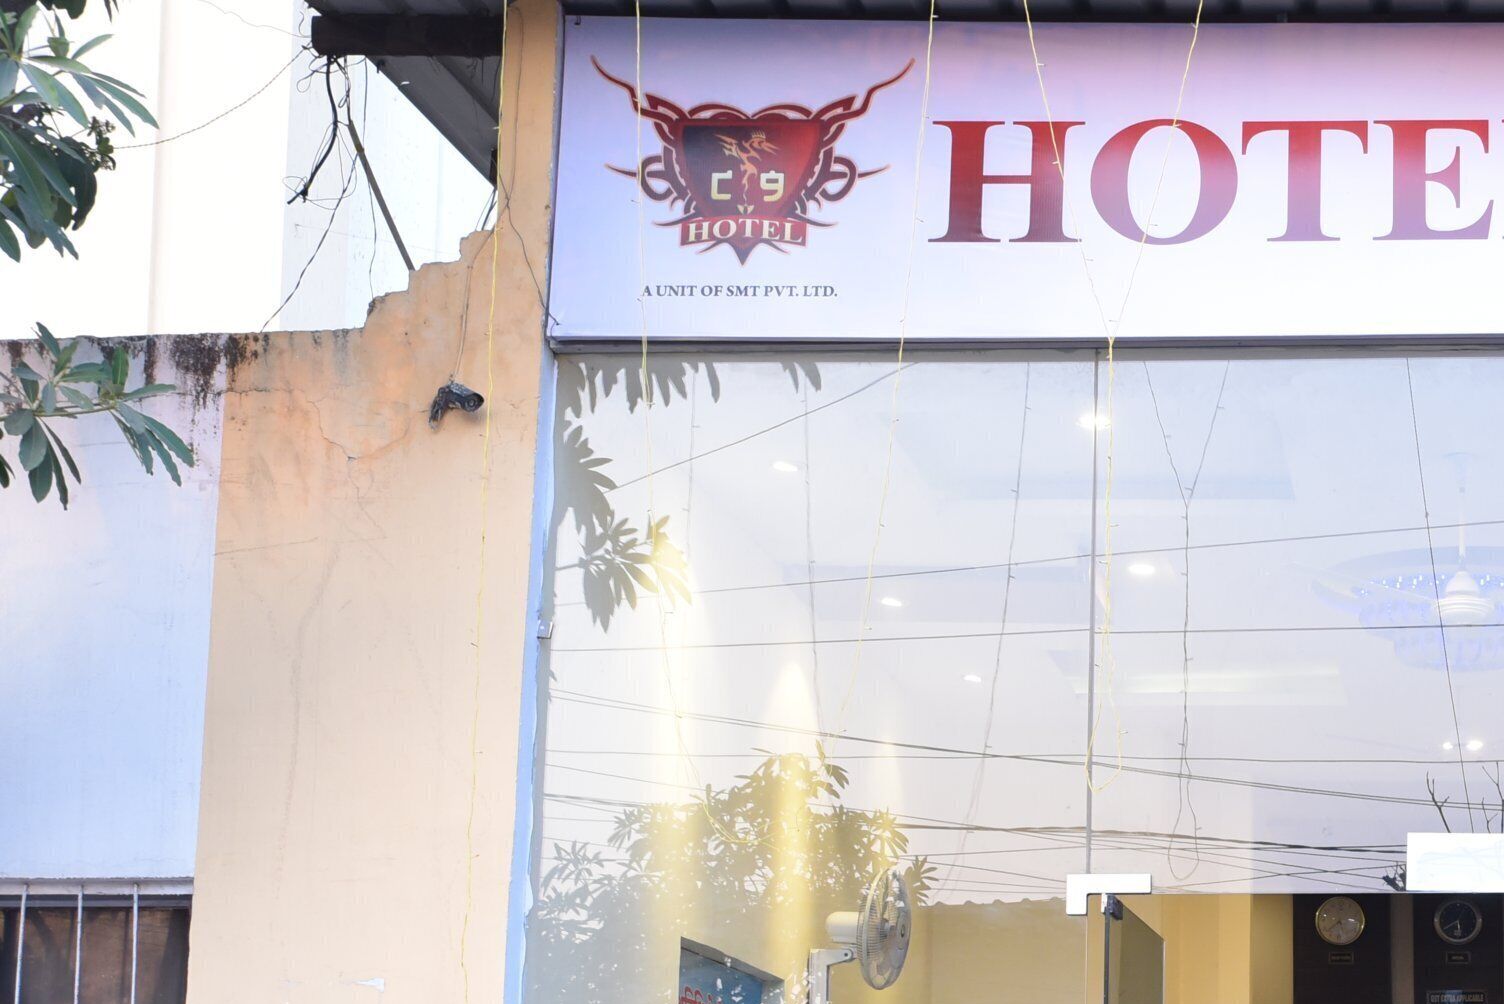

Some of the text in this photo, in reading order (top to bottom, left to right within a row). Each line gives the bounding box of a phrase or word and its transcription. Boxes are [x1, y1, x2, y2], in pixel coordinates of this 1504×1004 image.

[687, 217, 804, 245] HOTEL
[642, 285, 838, 297] A UNIT OF SMT PVT. LTD.
